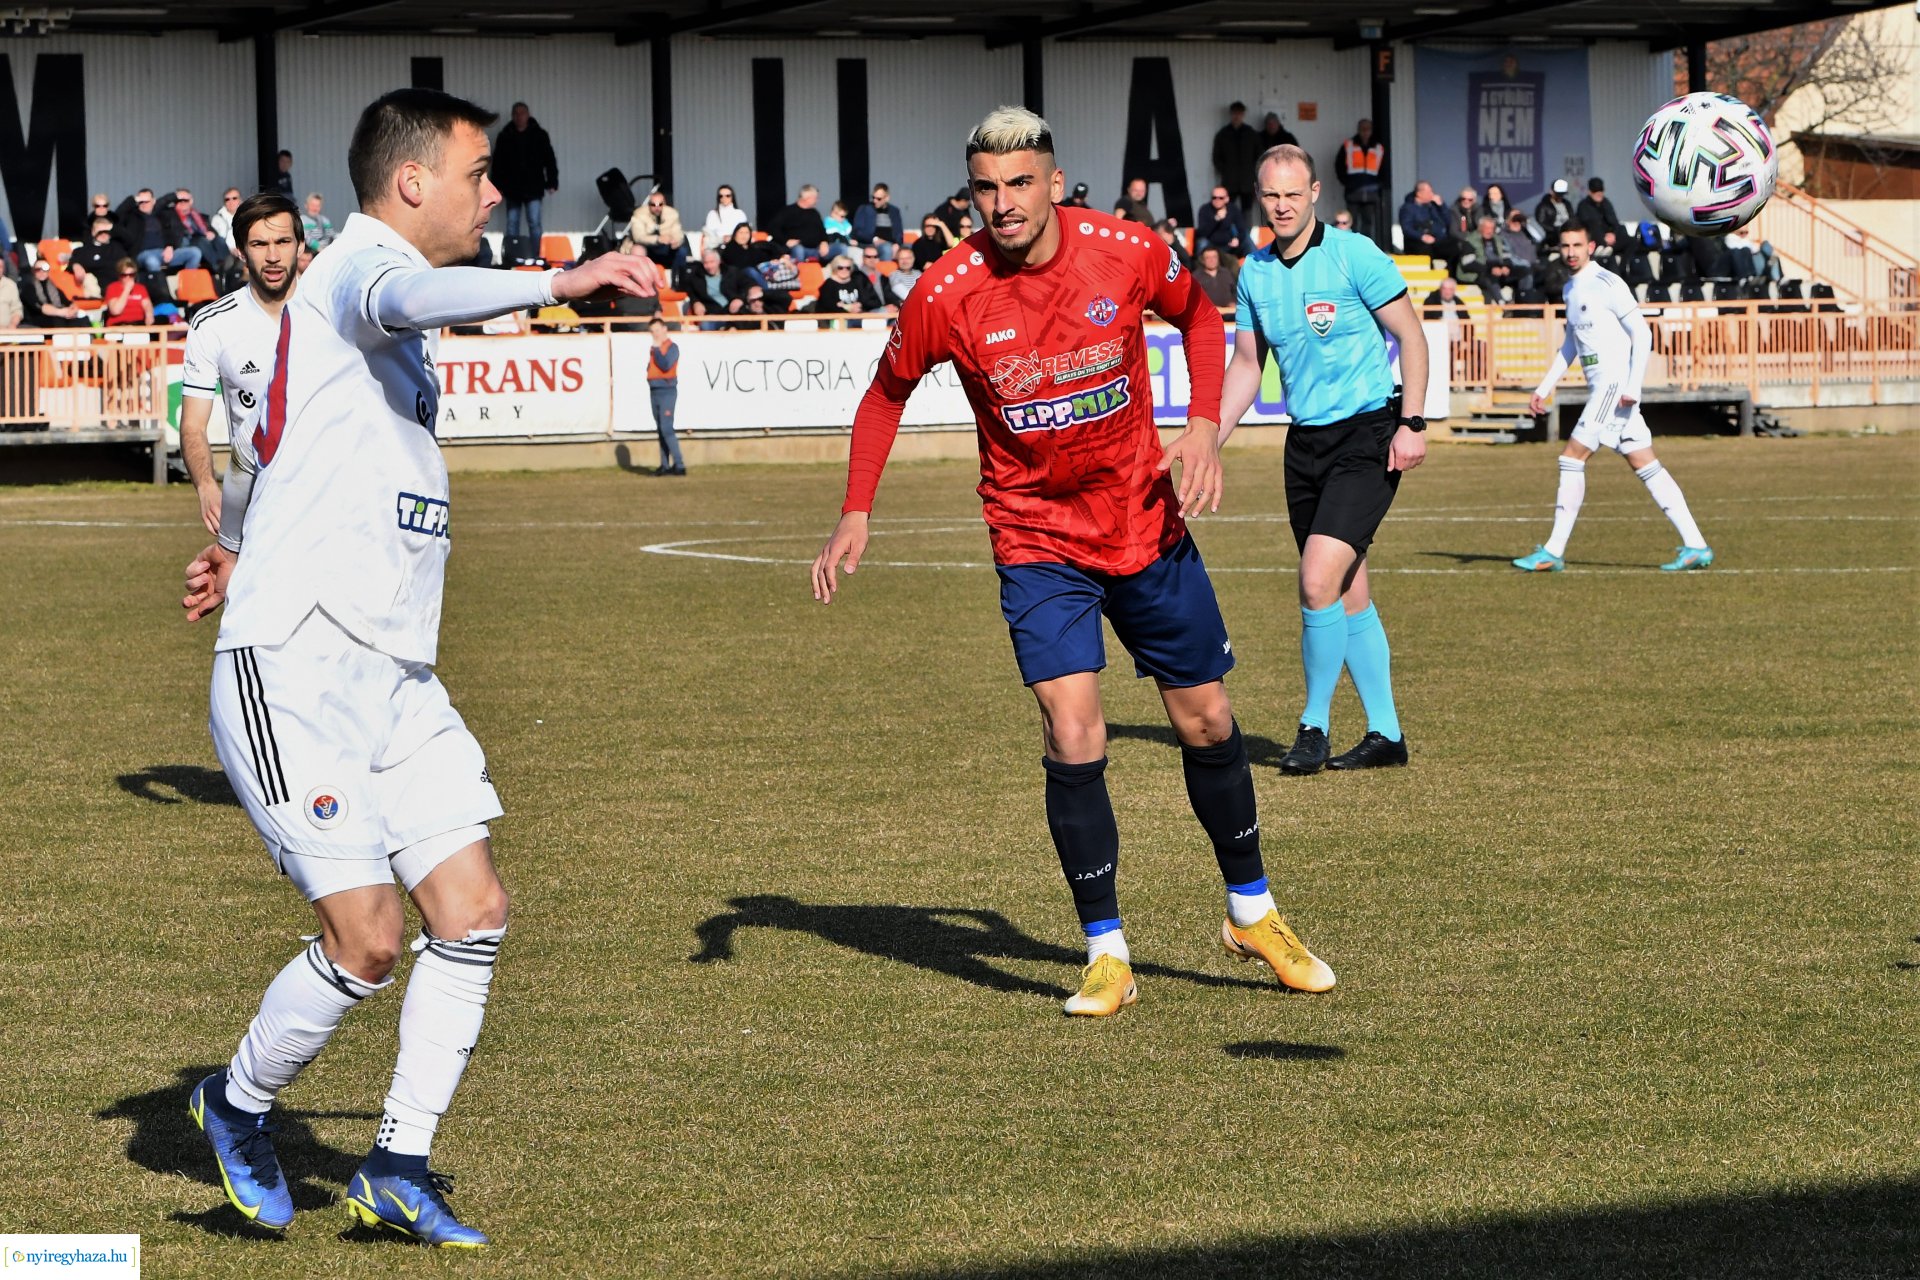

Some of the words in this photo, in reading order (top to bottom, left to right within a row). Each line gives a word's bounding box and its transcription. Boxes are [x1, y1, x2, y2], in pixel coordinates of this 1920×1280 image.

[1478, 107, 1534, 147] NEM
[1479, 148, 1533, 178] PÁLYA!
[985, 328, 1016, 345] JAKO
[703, 358, 856, 393] VICTORIA
[1086, 366, 1096, 374] THE
[1075, 863, 1112, 881] JAKO
